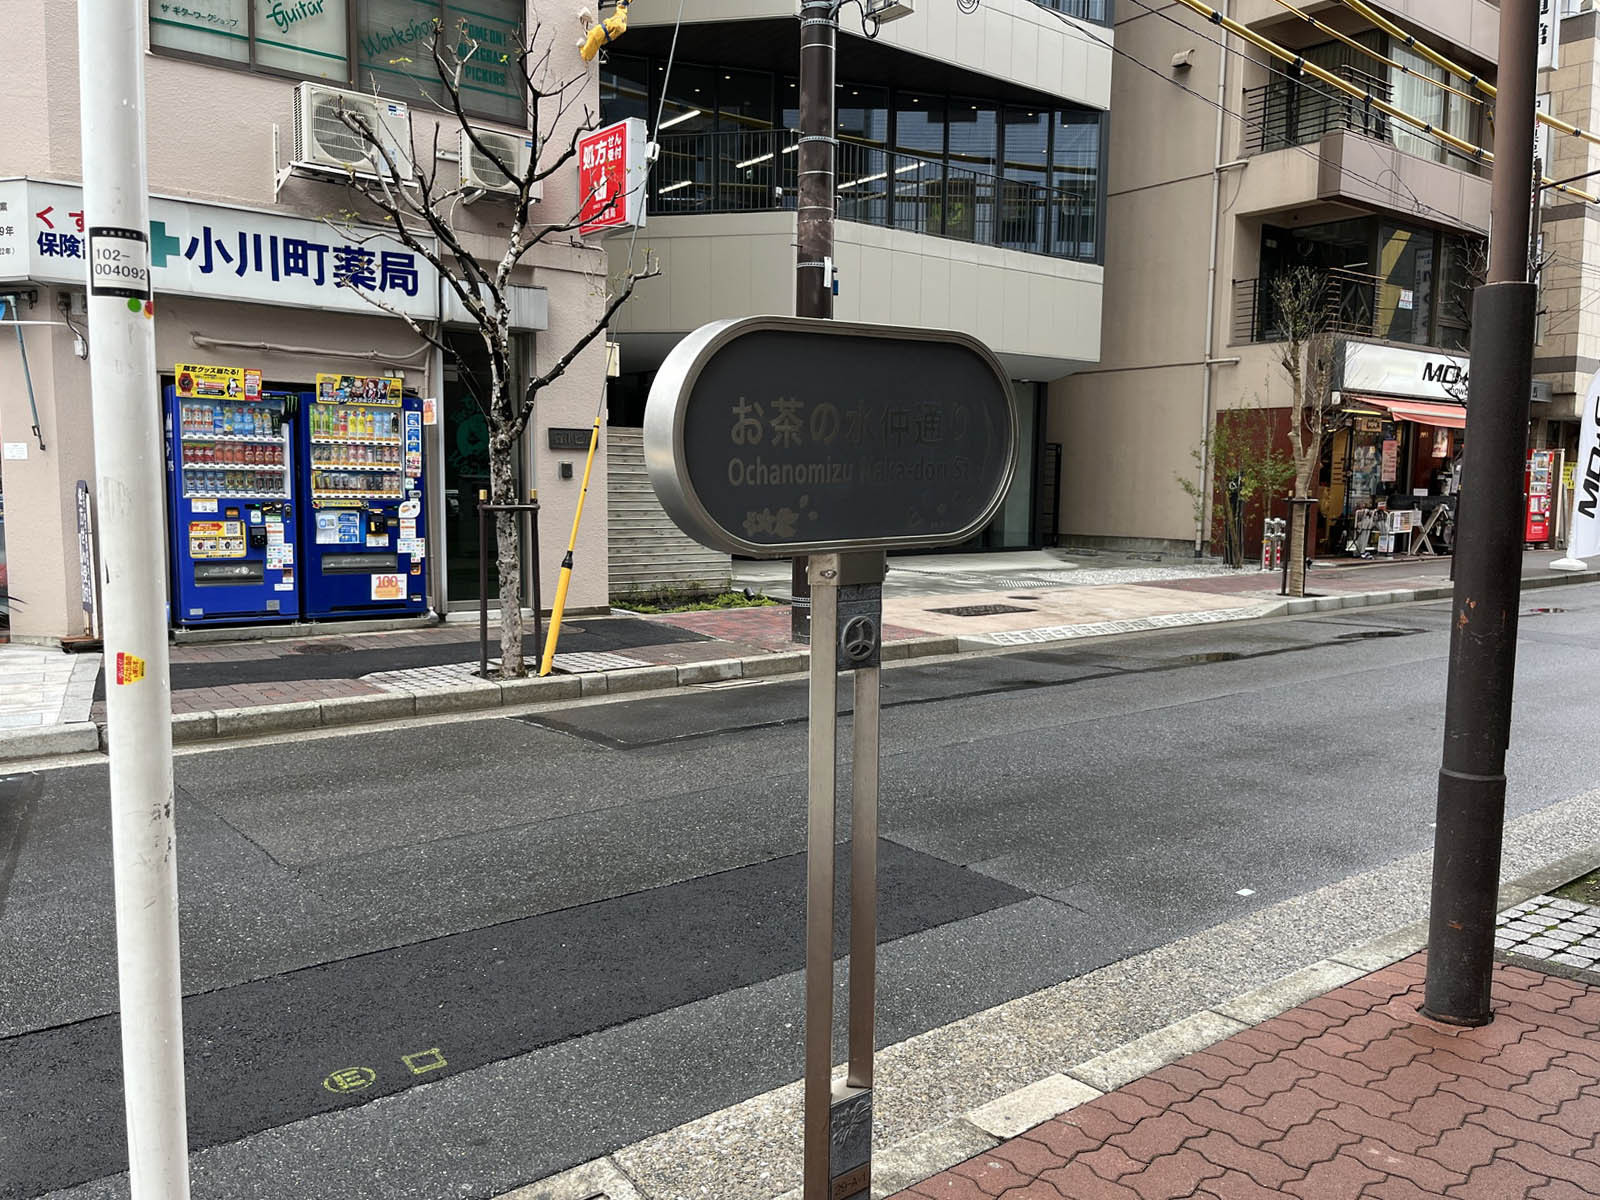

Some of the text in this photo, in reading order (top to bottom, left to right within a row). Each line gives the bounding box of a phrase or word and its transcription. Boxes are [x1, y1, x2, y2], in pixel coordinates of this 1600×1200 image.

[266, 0, 323, 33] Guitar
[583, 133, 622, 170] 処方 せん
[37, 231, 85, 259] 保険
[185, 226, 418, 296] 小川町薬局
[95, 263, 146, 280] 004092
[729, 395, 970, 448] お茶の水仲通り
[728, 456, 852, 486] Ochanomizu
